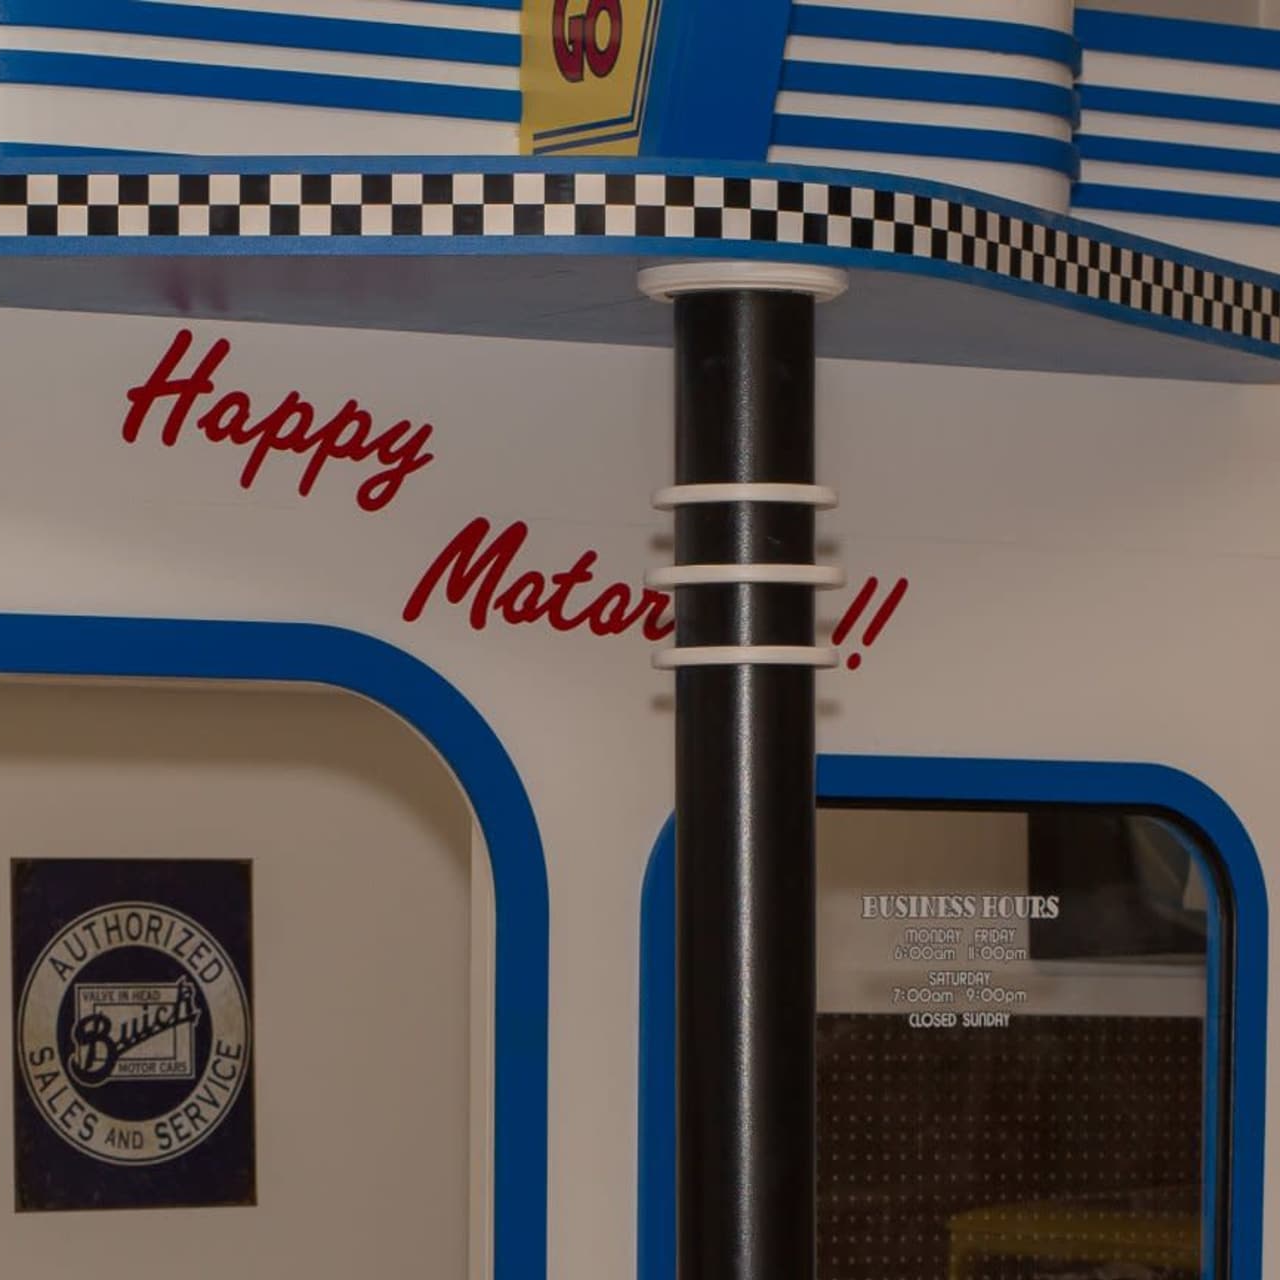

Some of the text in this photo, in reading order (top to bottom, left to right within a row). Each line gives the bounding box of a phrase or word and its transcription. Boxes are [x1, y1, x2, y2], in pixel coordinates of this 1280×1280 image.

[552, 0, 623, 83] GO
[121, 329, 434, 512] Happy
[862, 895, 1060, 919] BUSINESS HOURS
[49, 911, 226, 986] AUTHORIZED
[928, 971, 992, 986] SATURDAY
[70, 978, 198, 1083] Buick
[908, 1012, 1011, 1028] CLOSED SUNDAY
[29, 1040, 242, 1150] SALES AND SERVICE
